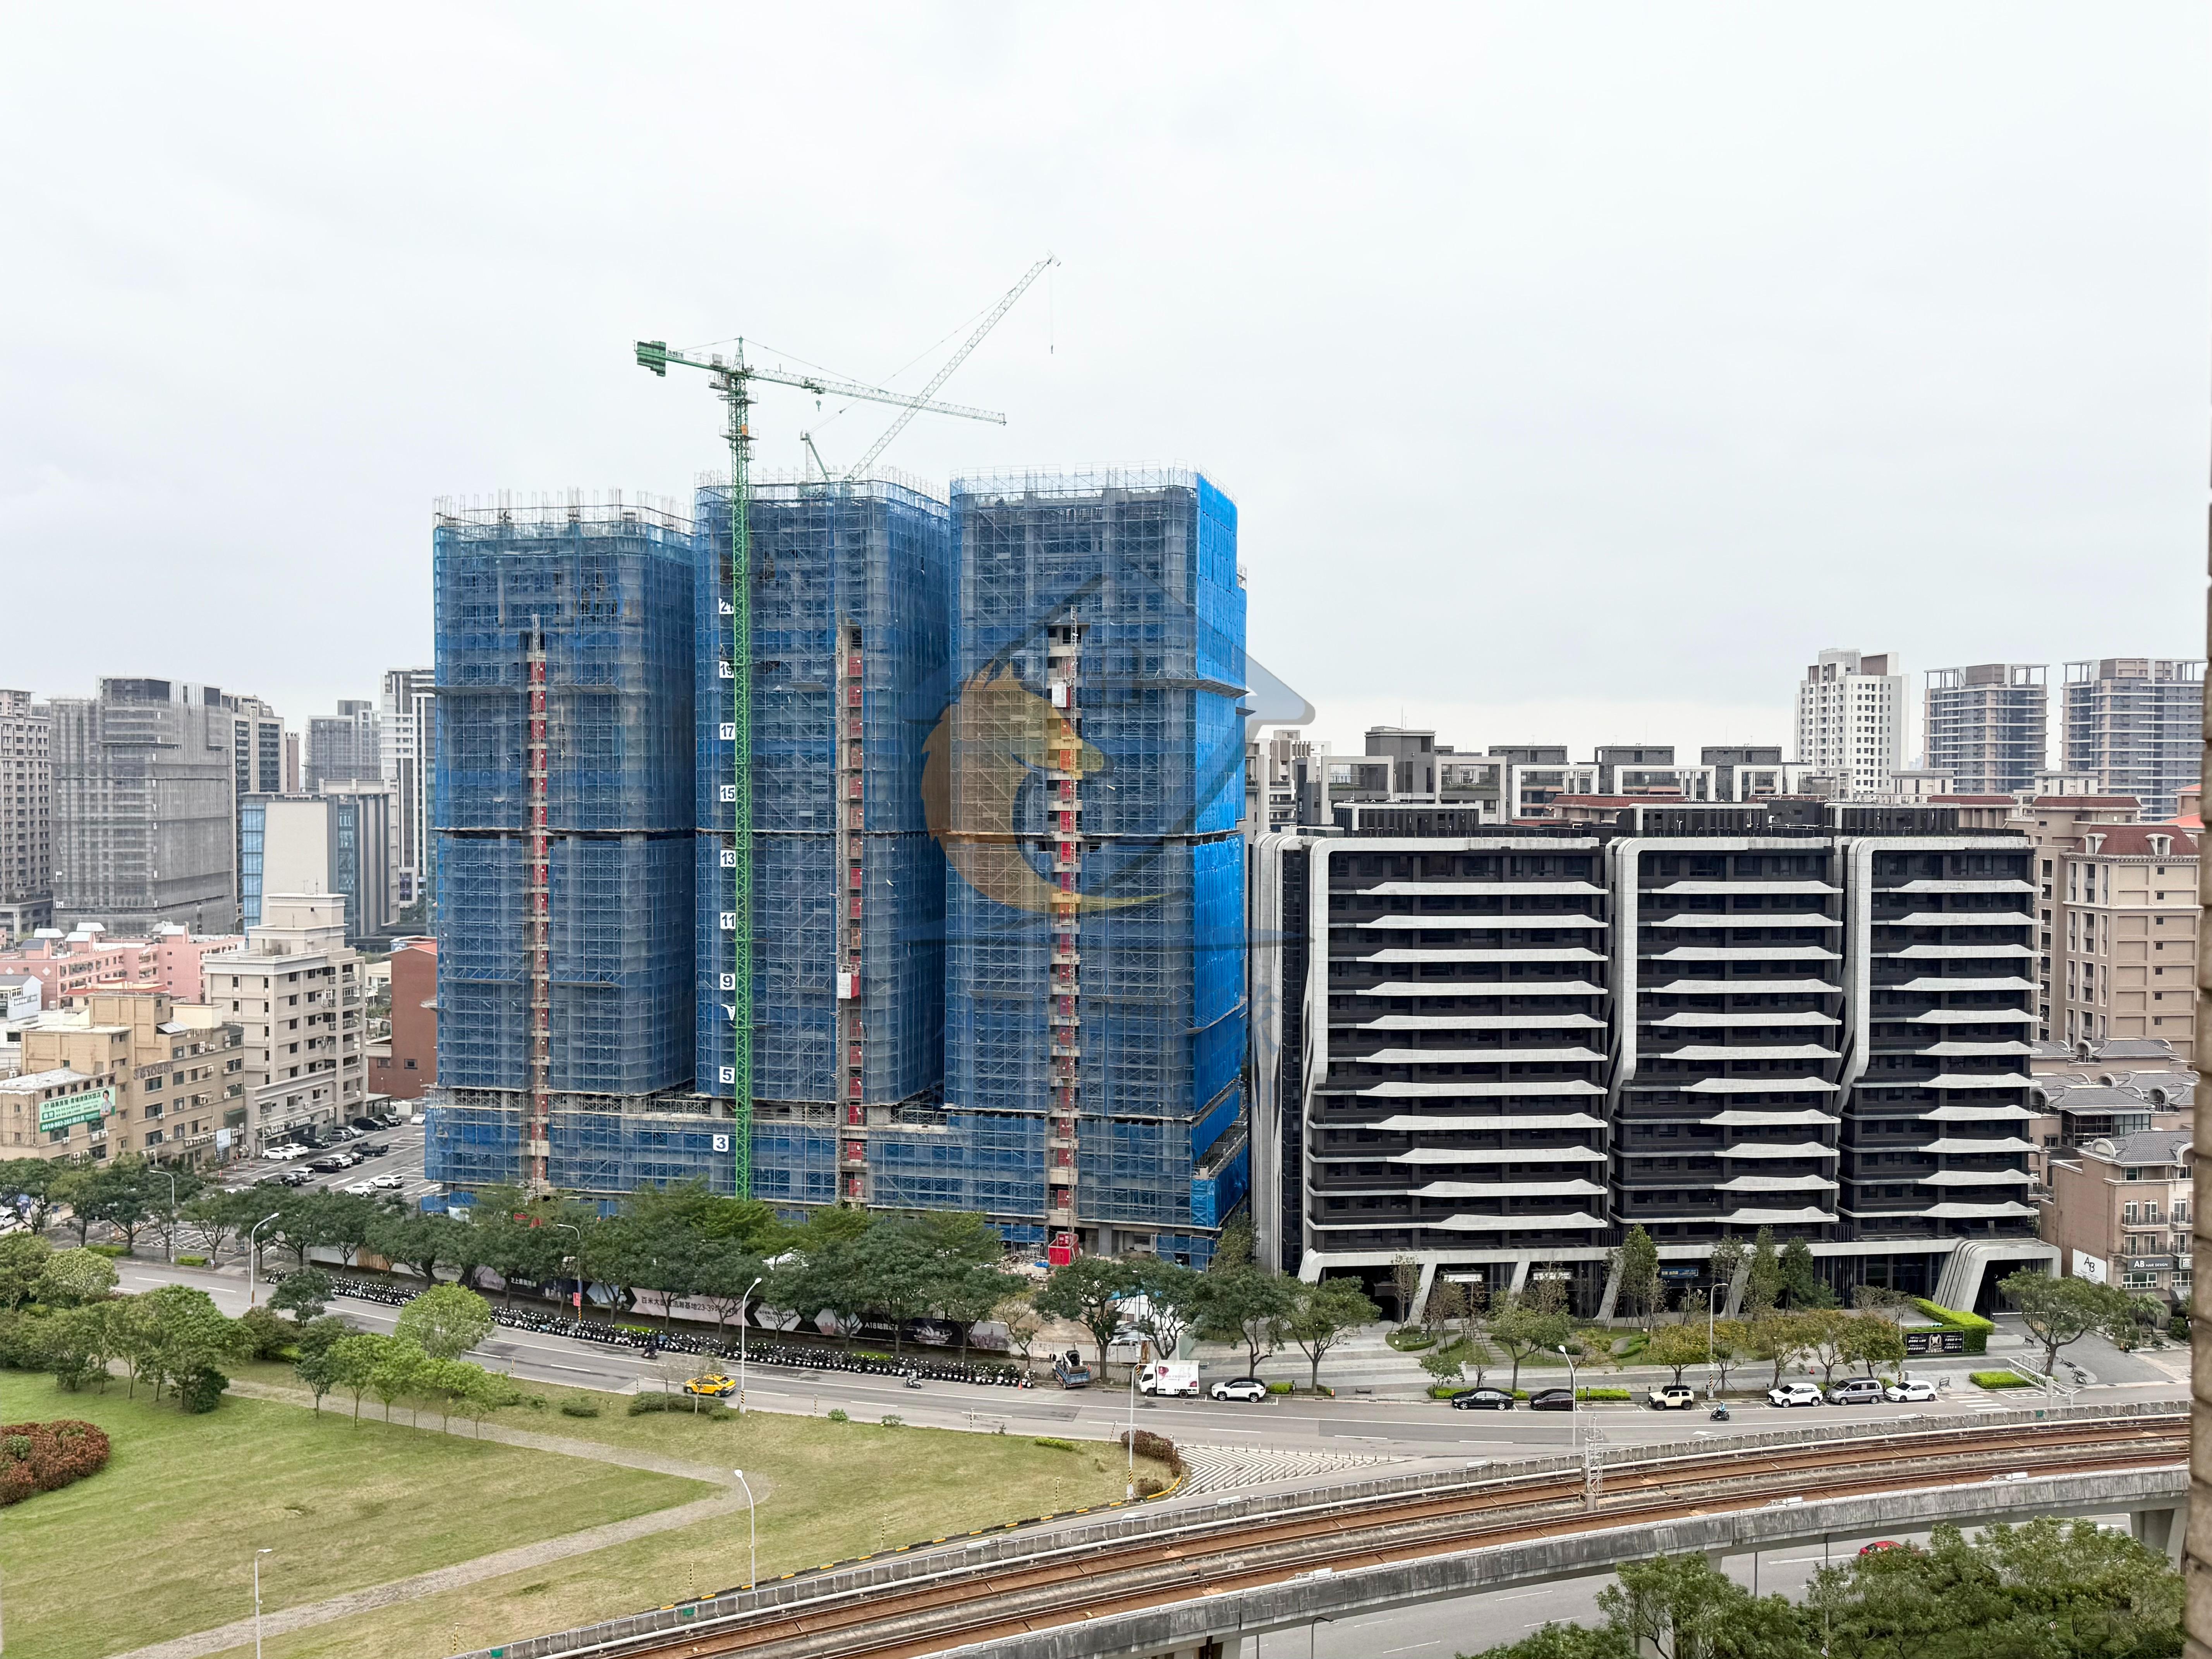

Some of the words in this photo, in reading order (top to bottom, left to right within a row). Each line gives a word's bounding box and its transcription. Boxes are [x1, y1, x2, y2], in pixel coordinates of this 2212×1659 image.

[721, 725, 734, 737] 17
[721, 787, 735, 799] 15
[721, 852, 735, 864] 13
[721, 914, 735, 927] 11
[723, 975, 732, 988] 9
[722, 1069, 732, 1081] 5
[716, 1137, 726, 1149] 3
[2084, 1257, 2095, 1273] AB
